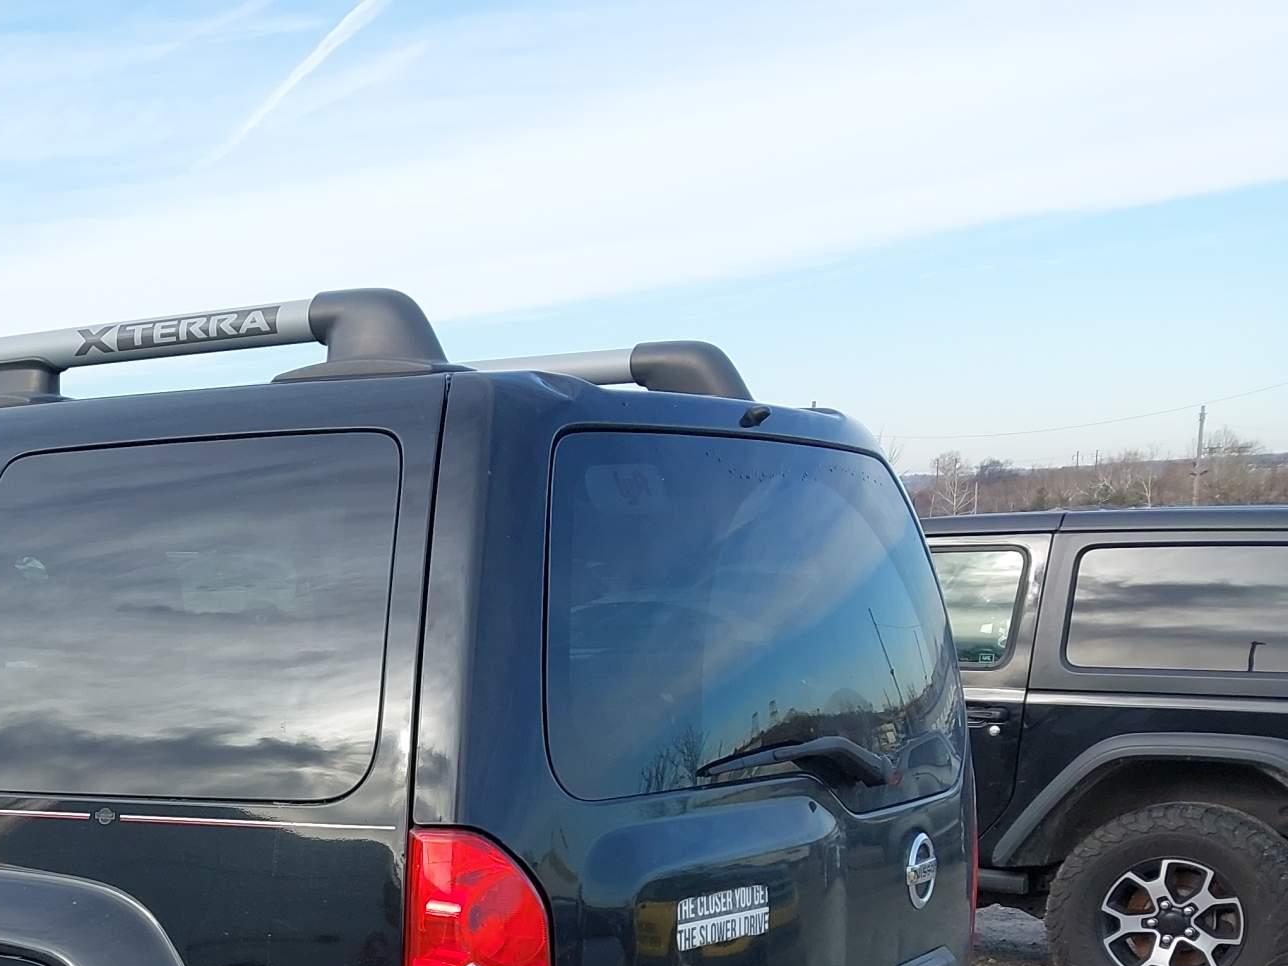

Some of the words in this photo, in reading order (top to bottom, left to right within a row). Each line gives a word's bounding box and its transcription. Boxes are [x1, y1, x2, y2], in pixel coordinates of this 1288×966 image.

[75, 308, 274, 356] XTERRA
[734, 886, 752, 909] YOU
[678, 926, 696, 951] THE
[699, 918, 737, 947] SLOWER
[744, 911, 769, 936] DRIVE
